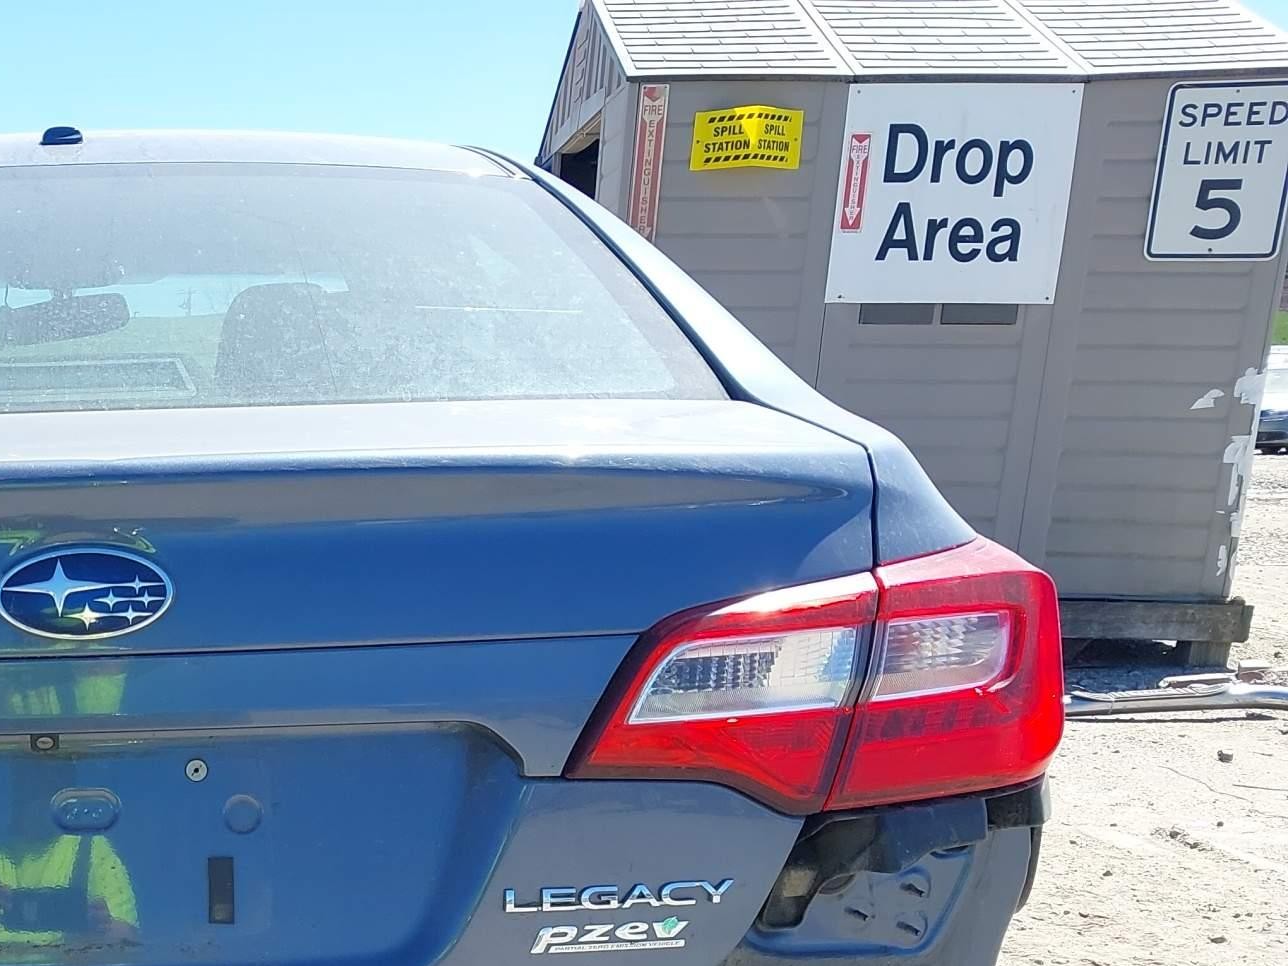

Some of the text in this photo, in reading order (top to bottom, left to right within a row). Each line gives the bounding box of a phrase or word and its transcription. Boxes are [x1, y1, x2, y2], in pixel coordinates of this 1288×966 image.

[643, 104, 664, 116] FIRE
[1178, 101, 1288, 129] SPEED
[713, 124, 745, 138] SPILL
[764, 123, 786, 137] SPILL
[703, 139, 751, 153] STATION
[757, 138, 790, 152] STATION
[851, 144, 869, 154] FIRE
[1183, 139, 1273, 166] LIMIT
[882, 123, 1034, 197] Drop
[638, 119, 656, 234] EXTINGUISHER
[1189, 178, 1244, 240] 5
[874, 201, 1022, 263] Area
[504, 878, 735, 913] LEGACY
[530, 917, 689, 954] pzev
